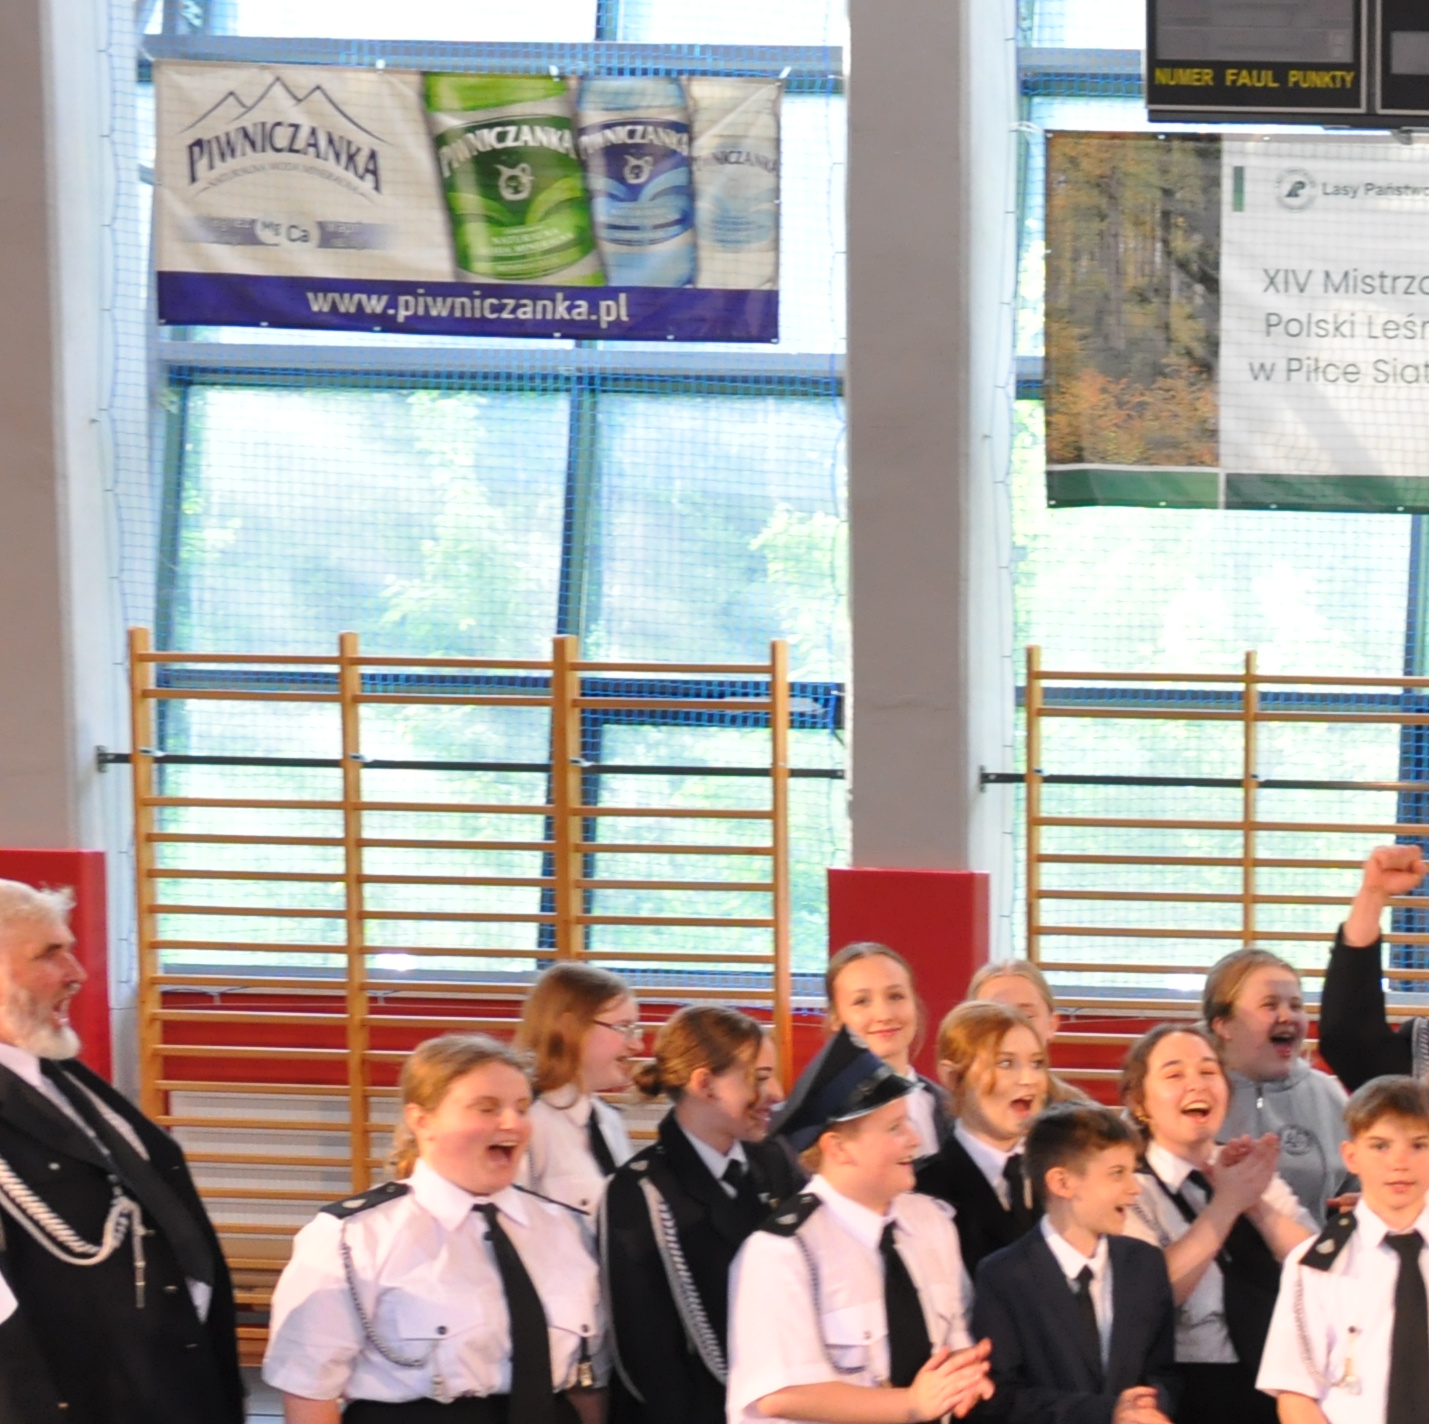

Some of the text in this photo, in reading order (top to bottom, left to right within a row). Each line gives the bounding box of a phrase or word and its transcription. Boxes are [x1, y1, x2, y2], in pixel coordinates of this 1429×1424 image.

[1155, 68, 1355, 88] NUMER FAUL PUNKTY
[187, 121, 383, 194] PIWNICZANKA
[1322, 182, 1359, 199] Lasy
[286, 225, 310, 243] Ca
[1263, 269, 1312, 294] XIV
[306, 288, 630, 329] www.piwniczanka.pl
[1265, 312, 1356, 338] Polski
[1249, 362, 1275, 381] w
[1286, 356, 1361, 383] Piłce
